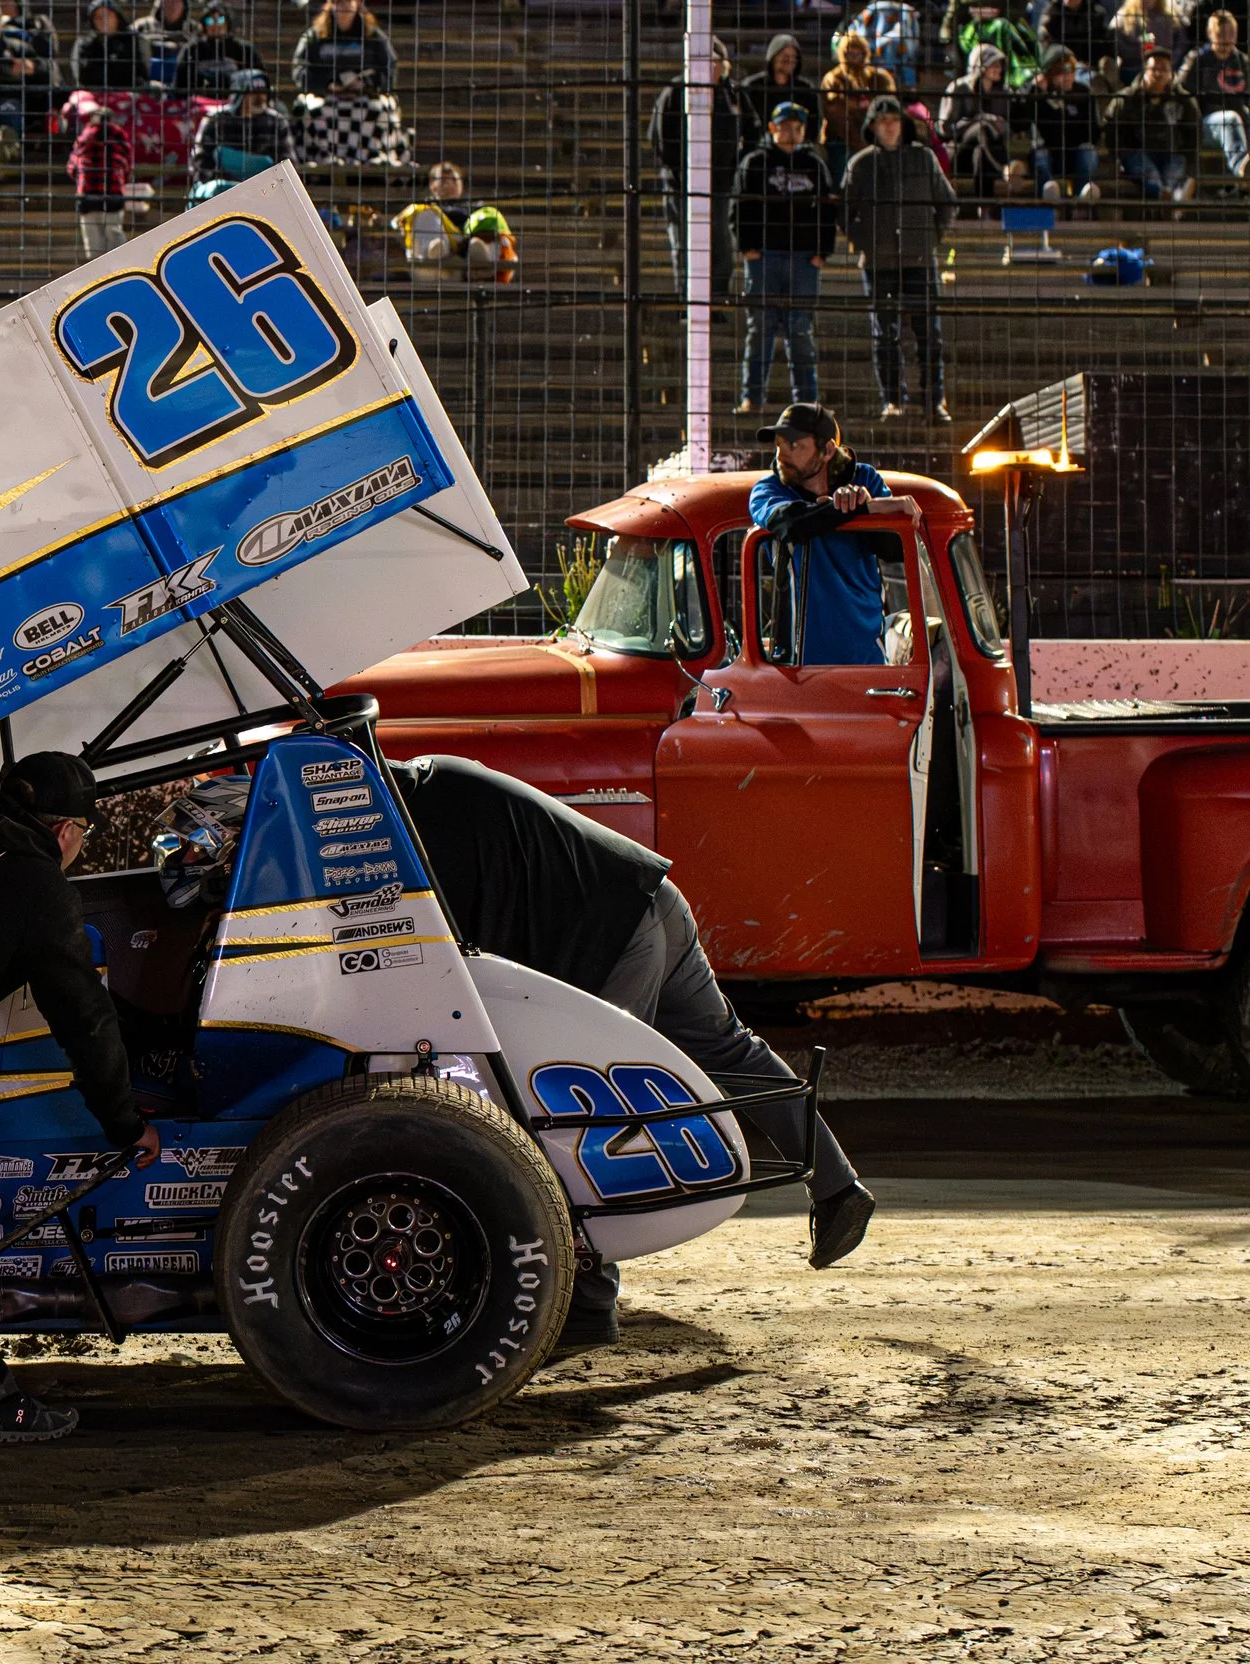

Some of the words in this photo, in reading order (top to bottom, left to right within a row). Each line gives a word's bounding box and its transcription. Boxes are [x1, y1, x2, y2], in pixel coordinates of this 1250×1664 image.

[53, 214, 359, 472] 26
[306, 501, 371, 540] RACING
[375, 478, 415, 502] OILS
[23, 610, 75, 644] BELL
[123, 601, 173, 633] FACTORY
[175, 582, 211, 607] KAHNE
[22, 626, 101, 676] COBALT
[35, 624, 72, 645] HELMETS
[302, 760, 362, 776] SHARP
[354, 920, 413, 938] ANDREWS
[528, 1060, 743, 1203] 26
[149, 1184, 223, 1200] QUICKCA
[239, 1155, 313, 1309] Hoosier
[111, 1256, 195, 1272] SCHOENFELD
[475, 1234, 548, 1385] Hoosier
